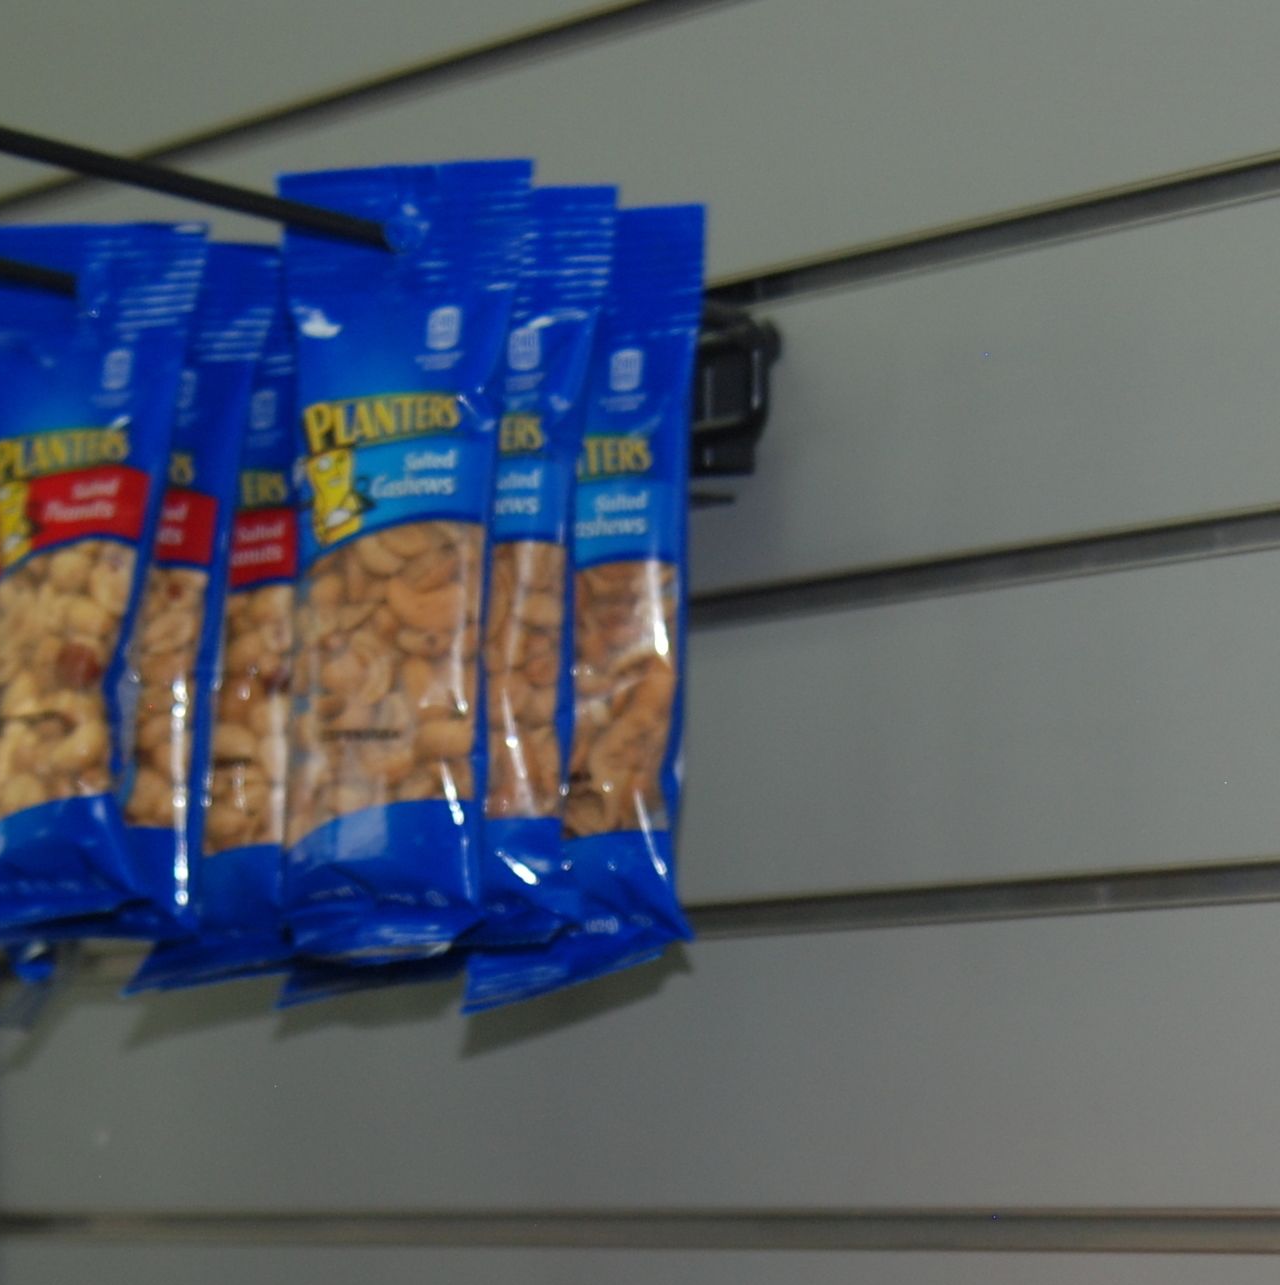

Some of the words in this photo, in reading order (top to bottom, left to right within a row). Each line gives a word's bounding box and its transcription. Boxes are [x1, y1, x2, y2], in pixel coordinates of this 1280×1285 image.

[304, 395, 461, 455] PLANTERS
[405, 449, 458, 472] Salted
[371, 474, 455, 499] Cashews
